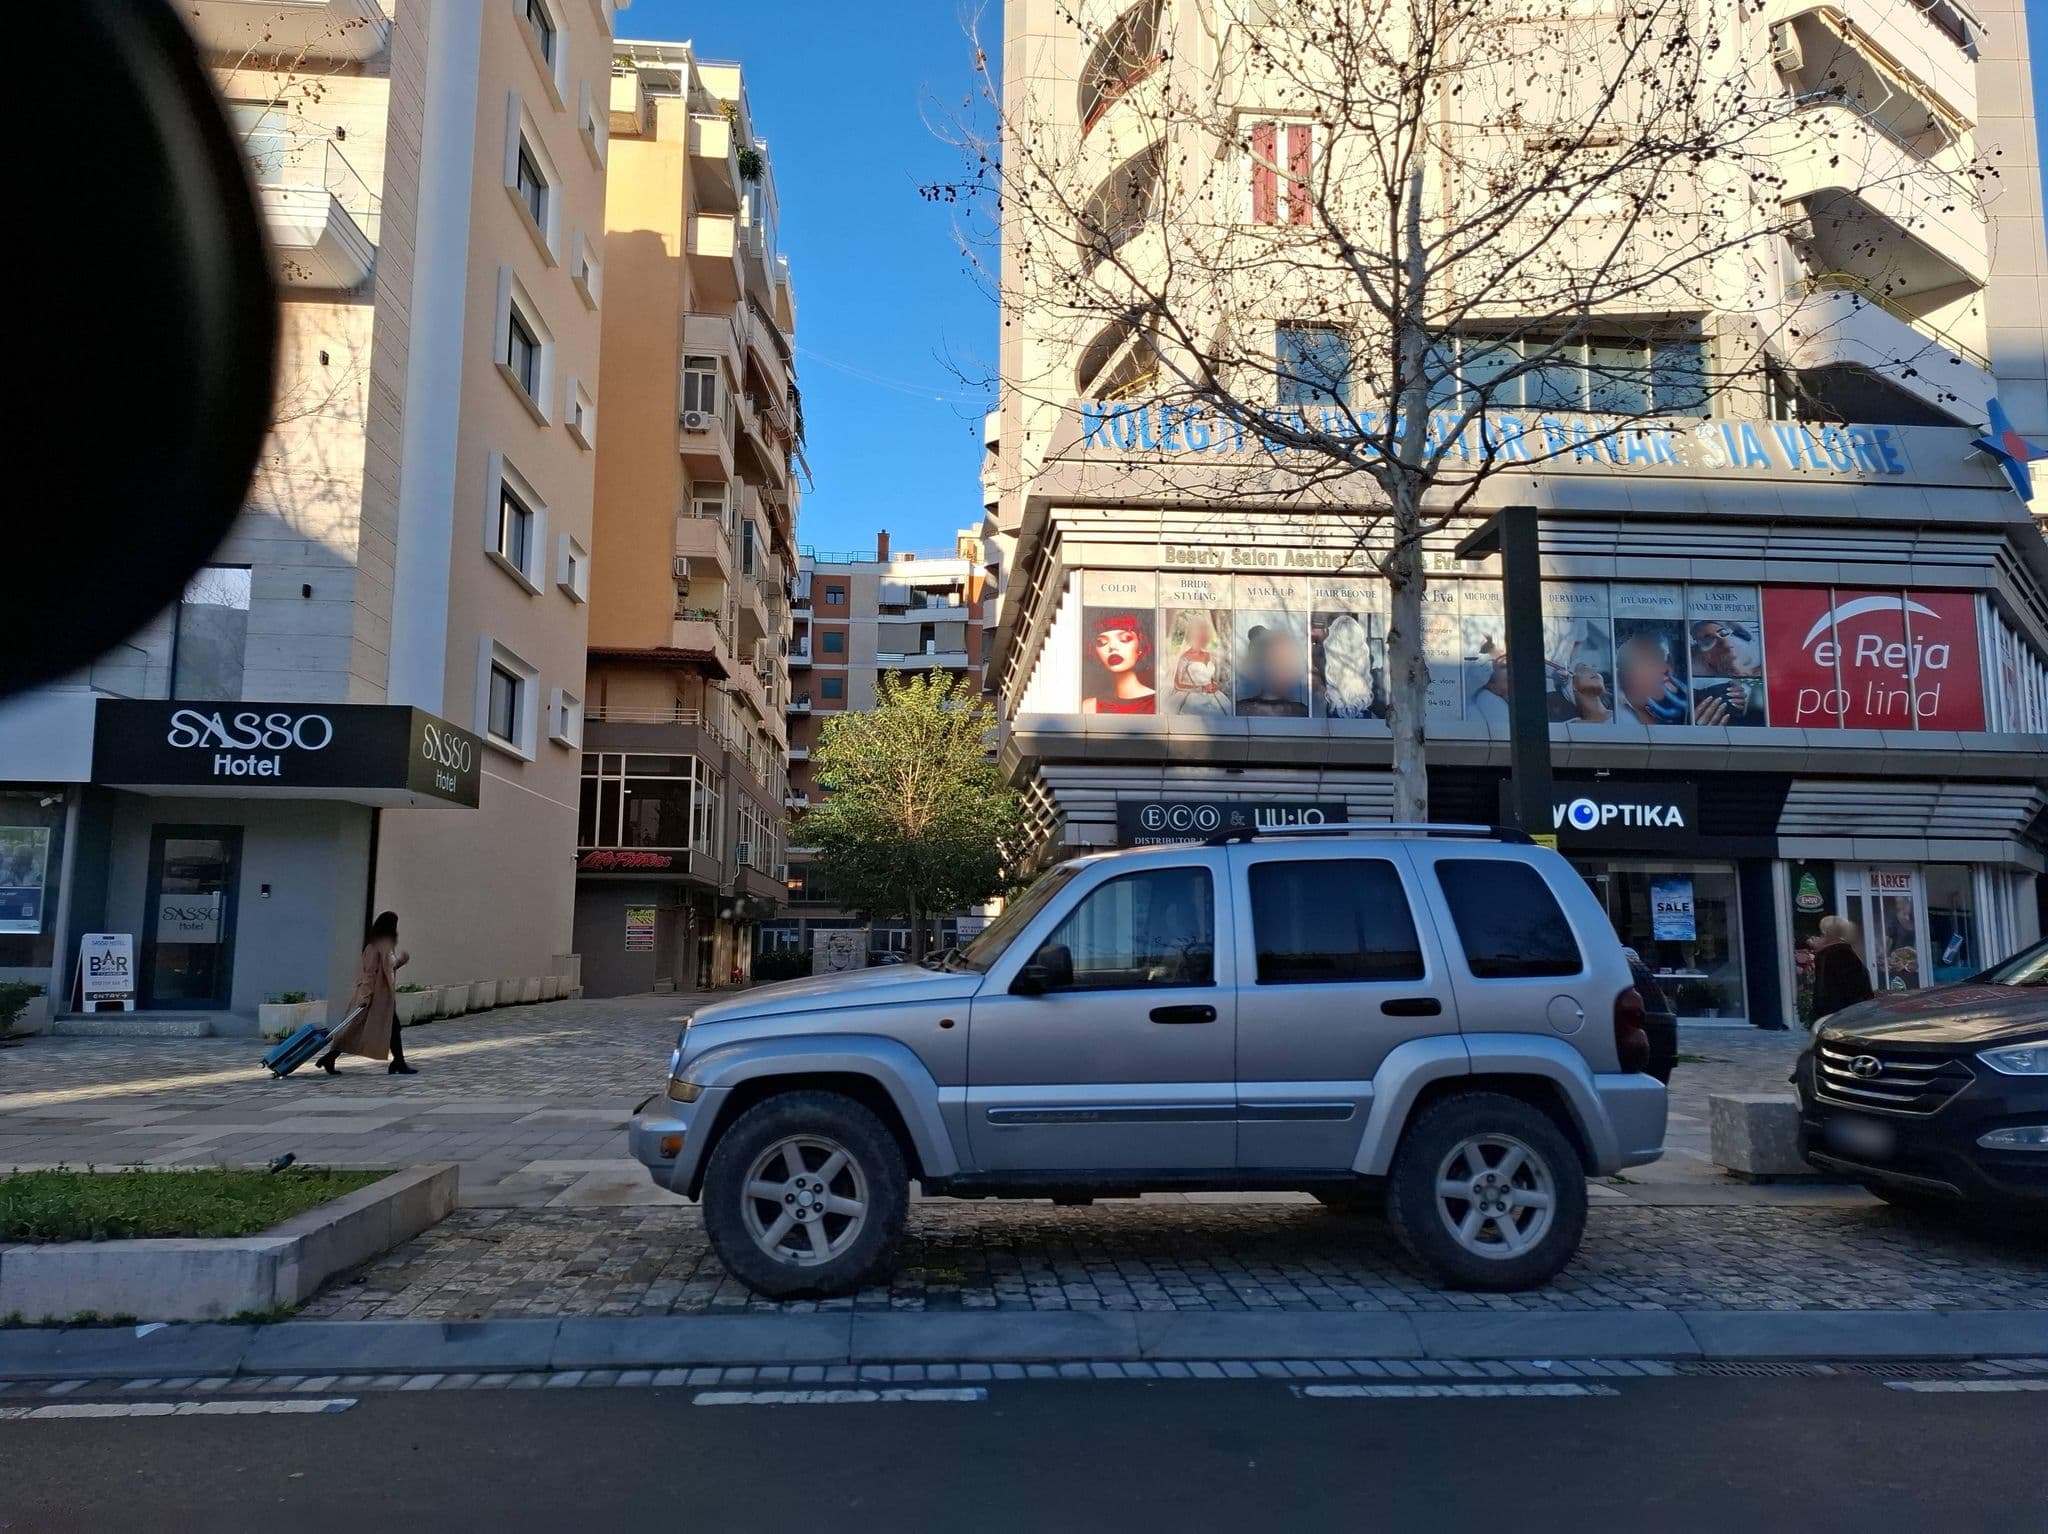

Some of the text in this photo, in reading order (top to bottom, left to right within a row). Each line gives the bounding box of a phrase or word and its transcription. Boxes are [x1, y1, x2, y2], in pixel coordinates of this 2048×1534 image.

[1164, 545, 1226, 568] Beauty
[1231, 548, 1278, 566] Salon
[1100, 583, 1138, 594] COLOR
[1433, 589, 1454, 603] Eva
[1814, 634, 1950, 679] e Reja
[1795, 680, 1941, 724] po lind
[167, 709, 333, 750] SASSO
[422, 723, 471, 773] SASSO
[213, 753, 282, 776] Hotel
[435, 769, 457, 793] Hotel
[1141, 804, 1221, 831] ECO
[1870, 874, 1911, 888] MARKET
[1657, 902, 1690, 912] SALE
[90, 949, 128, 972] BAR
